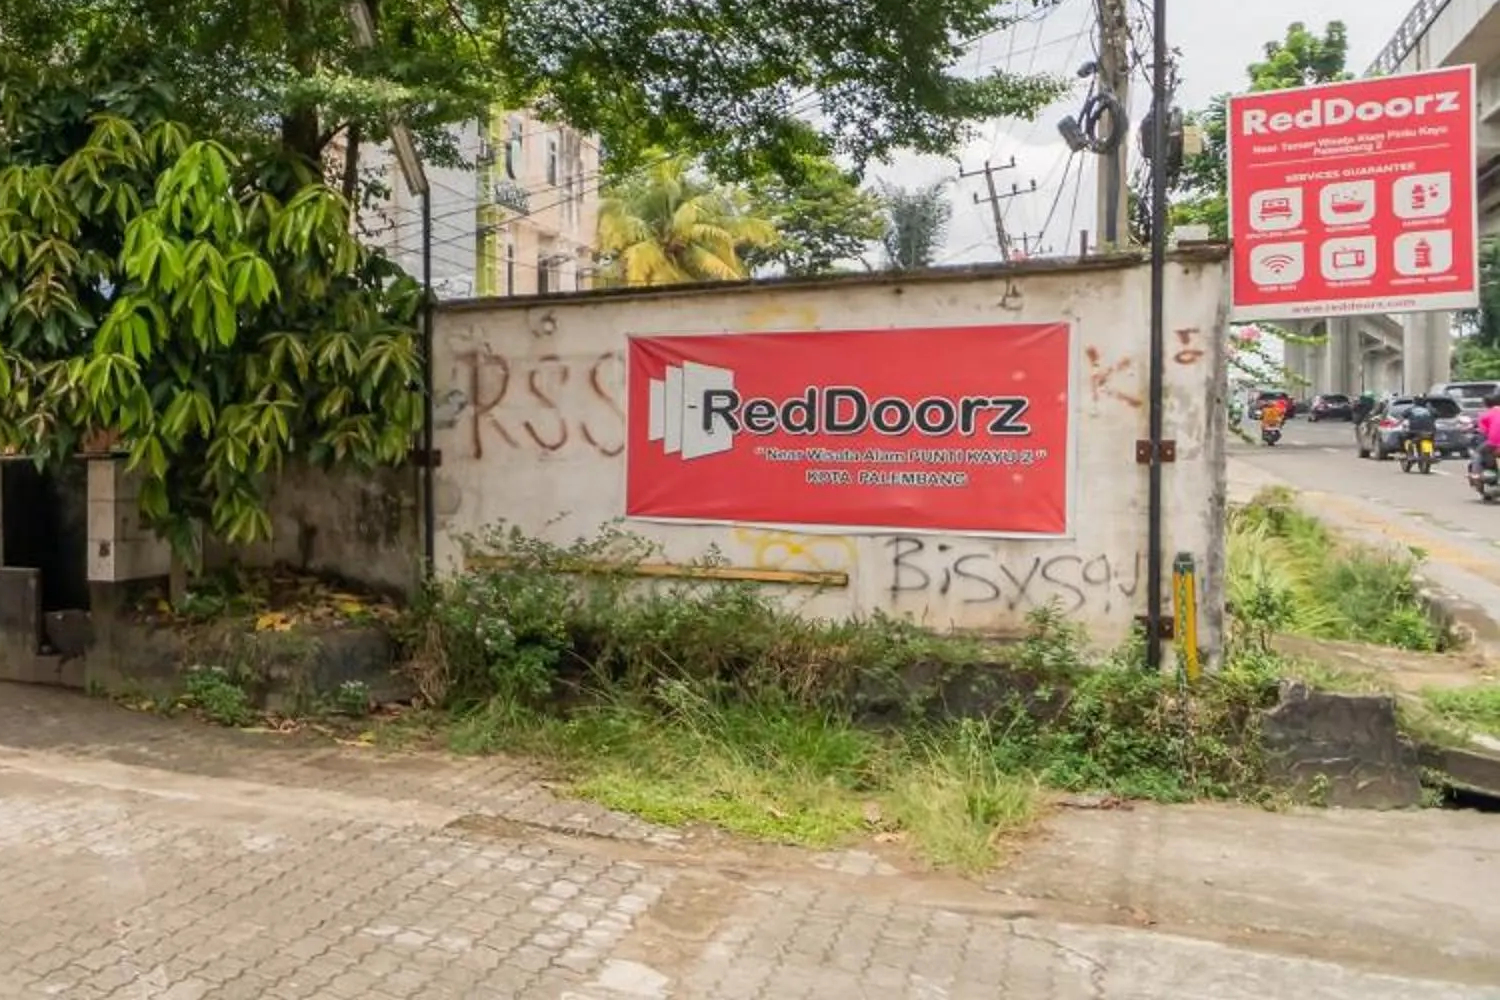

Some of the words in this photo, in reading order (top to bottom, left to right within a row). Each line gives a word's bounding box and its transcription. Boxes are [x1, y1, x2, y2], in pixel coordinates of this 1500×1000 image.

[1242, 91, 1460, 136] RedDoorz
[1285, 170, 1340, 183] SERVICES
[1342, 161, 1417, 178] GUARANTEE
[700, 384, 1032, 438] RedDoorz
[805, 469, 851, 485] KOTA
[857, 470, 969, 487] PALEMBANG
